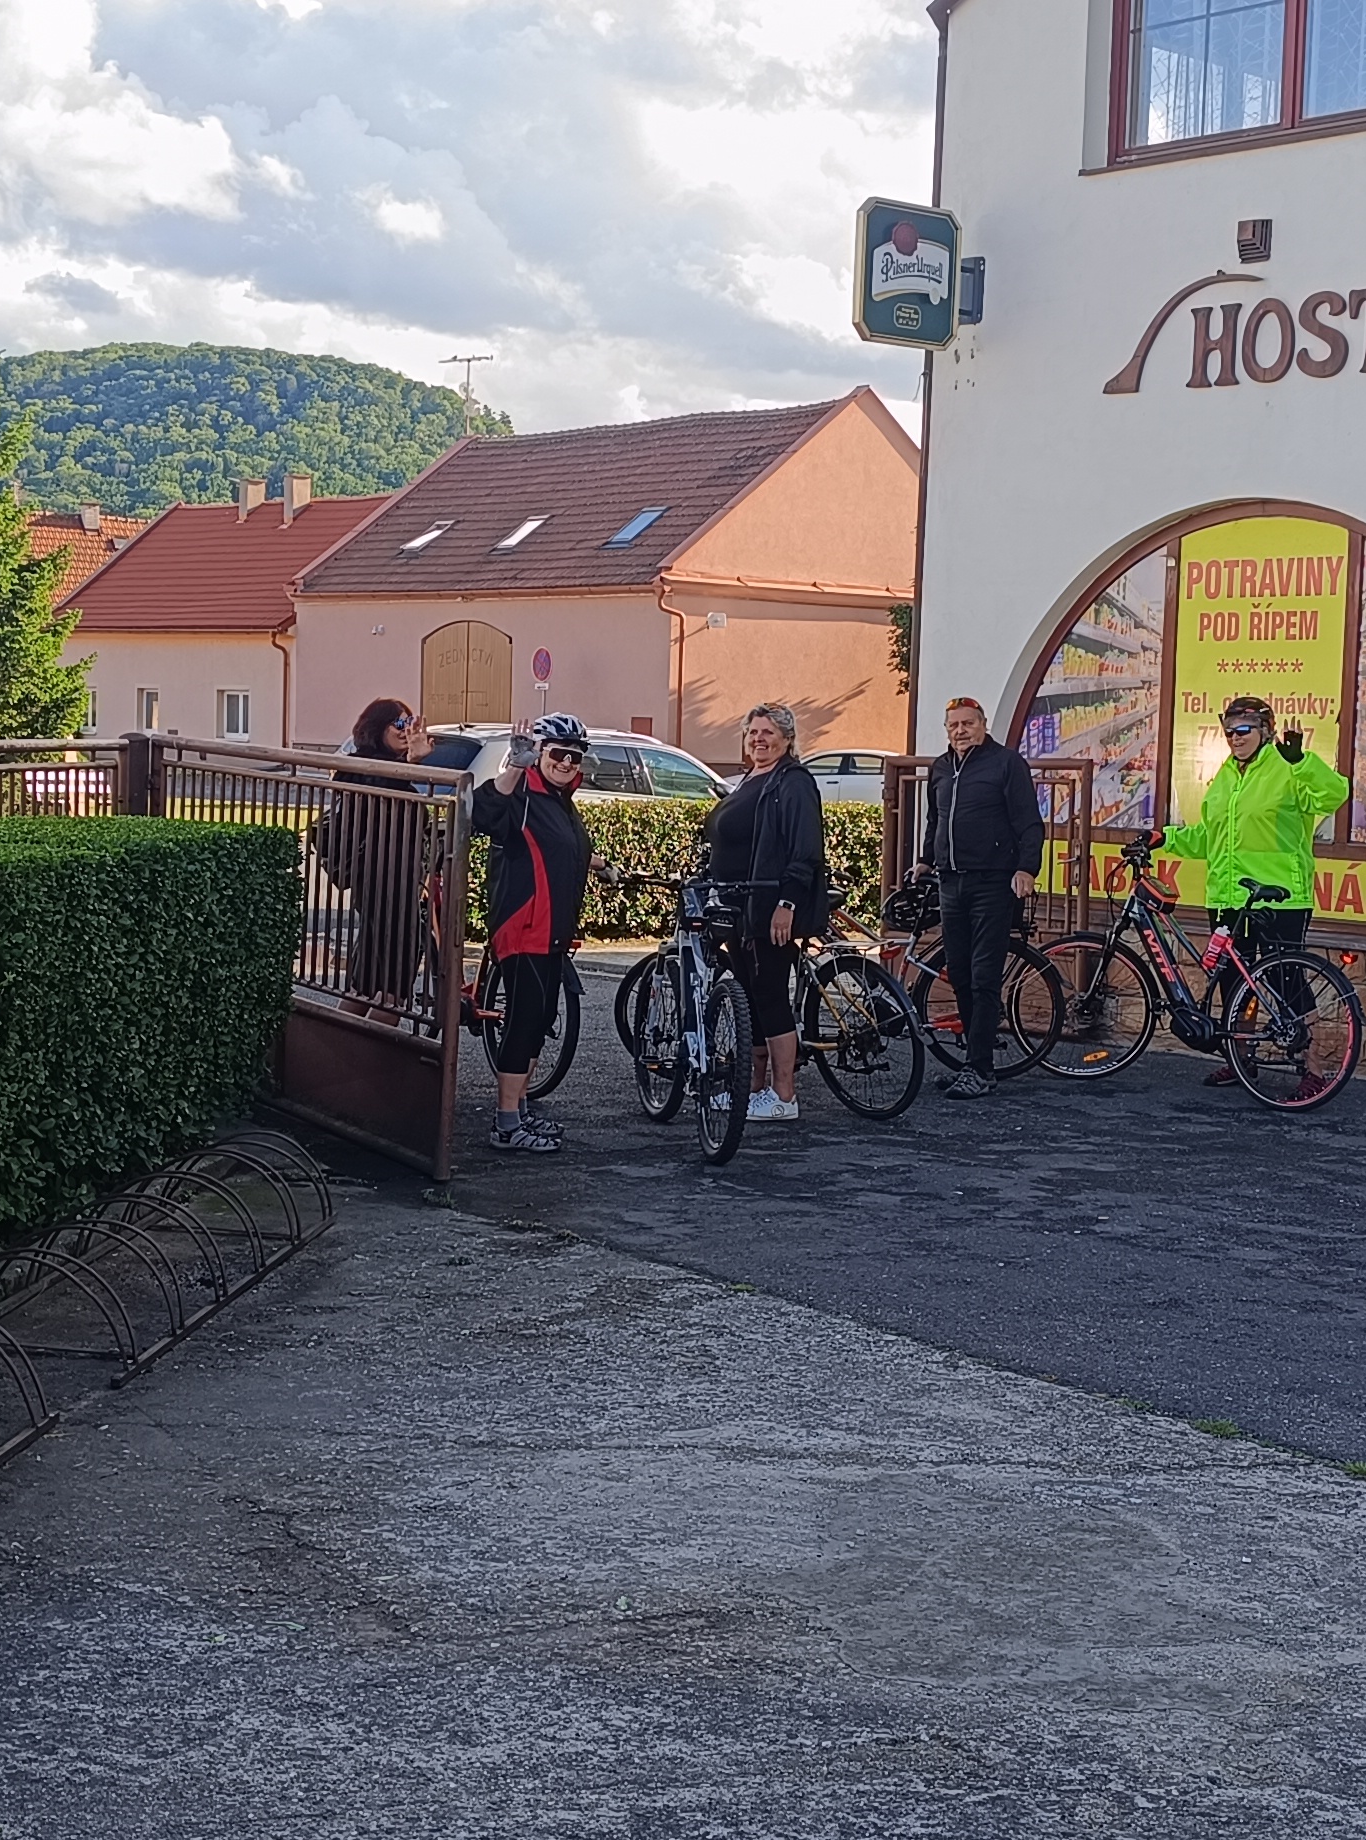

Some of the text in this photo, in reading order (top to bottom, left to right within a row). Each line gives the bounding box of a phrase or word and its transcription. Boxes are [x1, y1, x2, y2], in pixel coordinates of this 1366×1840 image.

[881, 252, 943, 283] Pilsner Urquell
[1186, 556, 1344, 599] POTRAVINY
[1199, 603, 1319, 641] POD ŘÍPEM
[1182, 692, 1335, 719] Tel. onávky:
[1143, 929, 1175, 982] MTF
